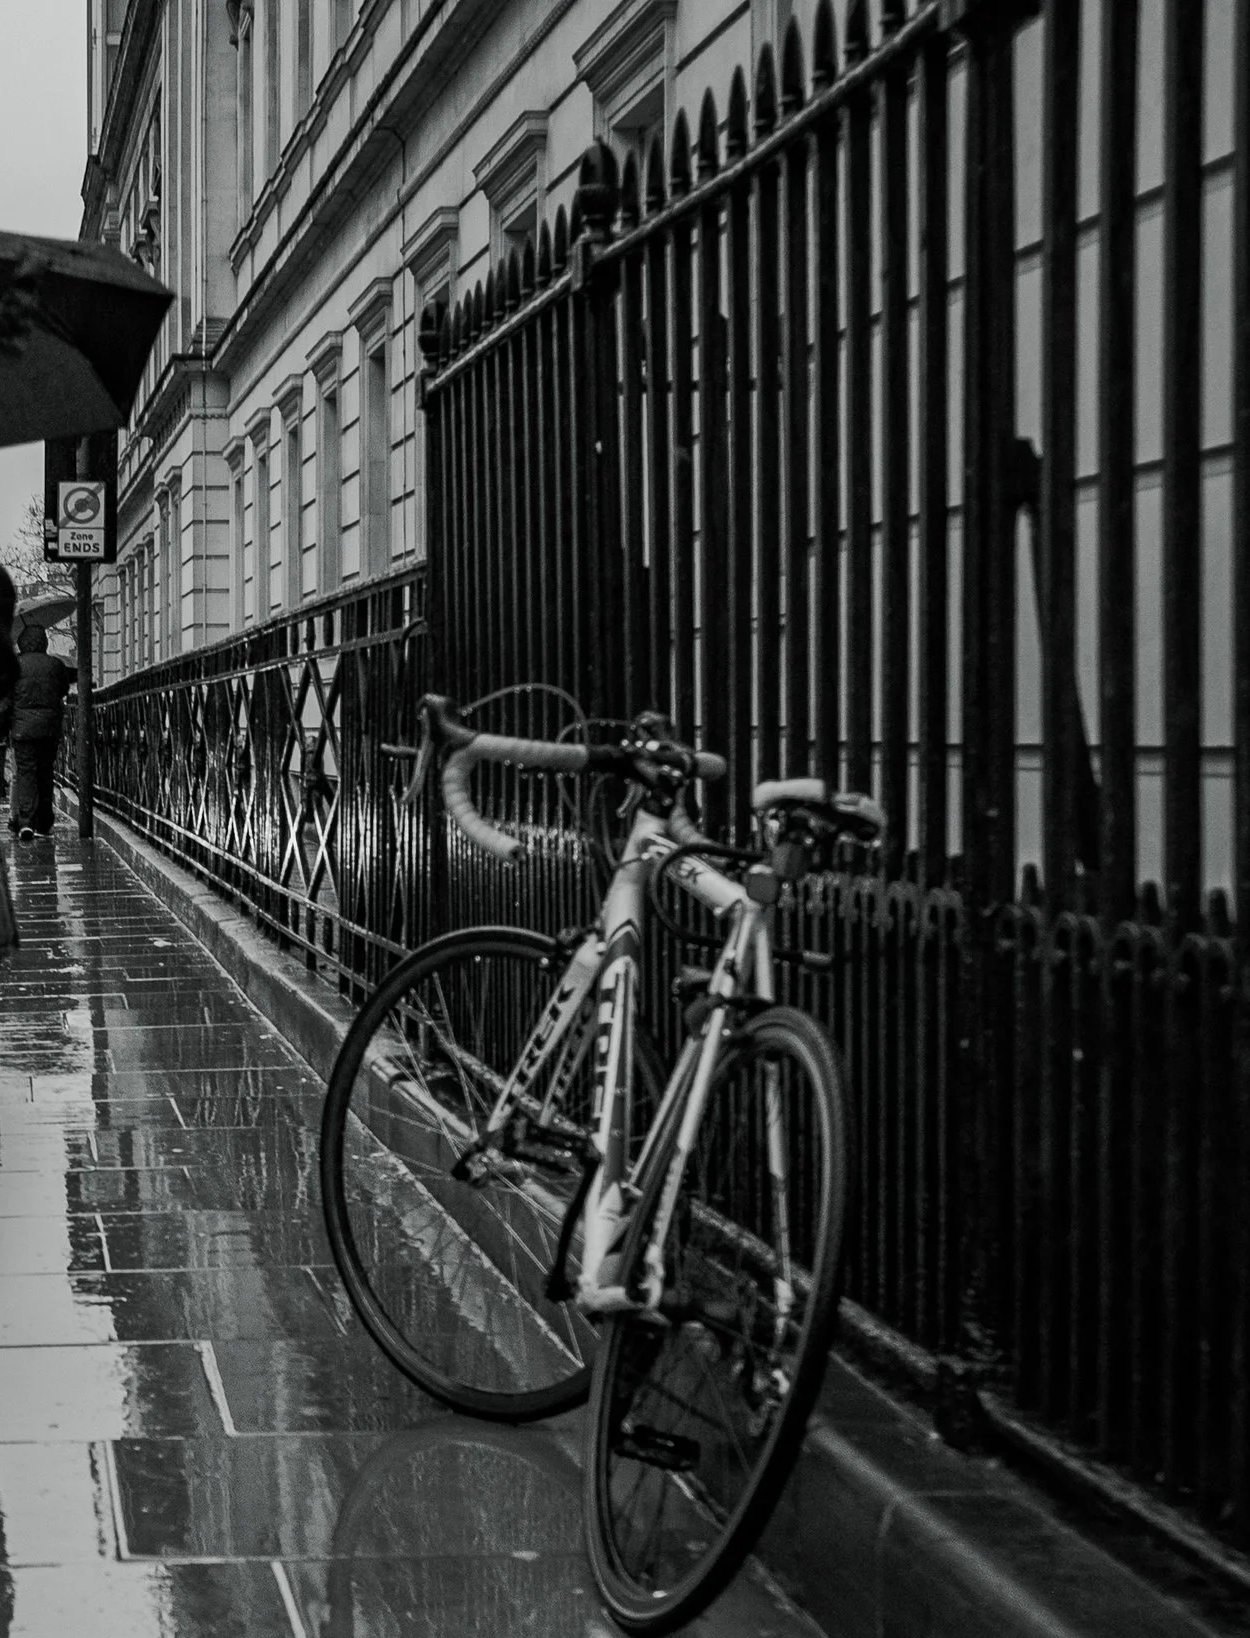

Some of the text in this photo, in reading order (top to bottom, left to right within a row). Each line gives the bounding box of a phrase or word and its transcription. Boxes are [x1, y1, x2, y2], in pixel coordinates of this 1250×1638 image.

[70, 531, 94, 541] Zone
[64, 542, 100, 553] ENDS
[502, 985, 576, 1112] TREK
